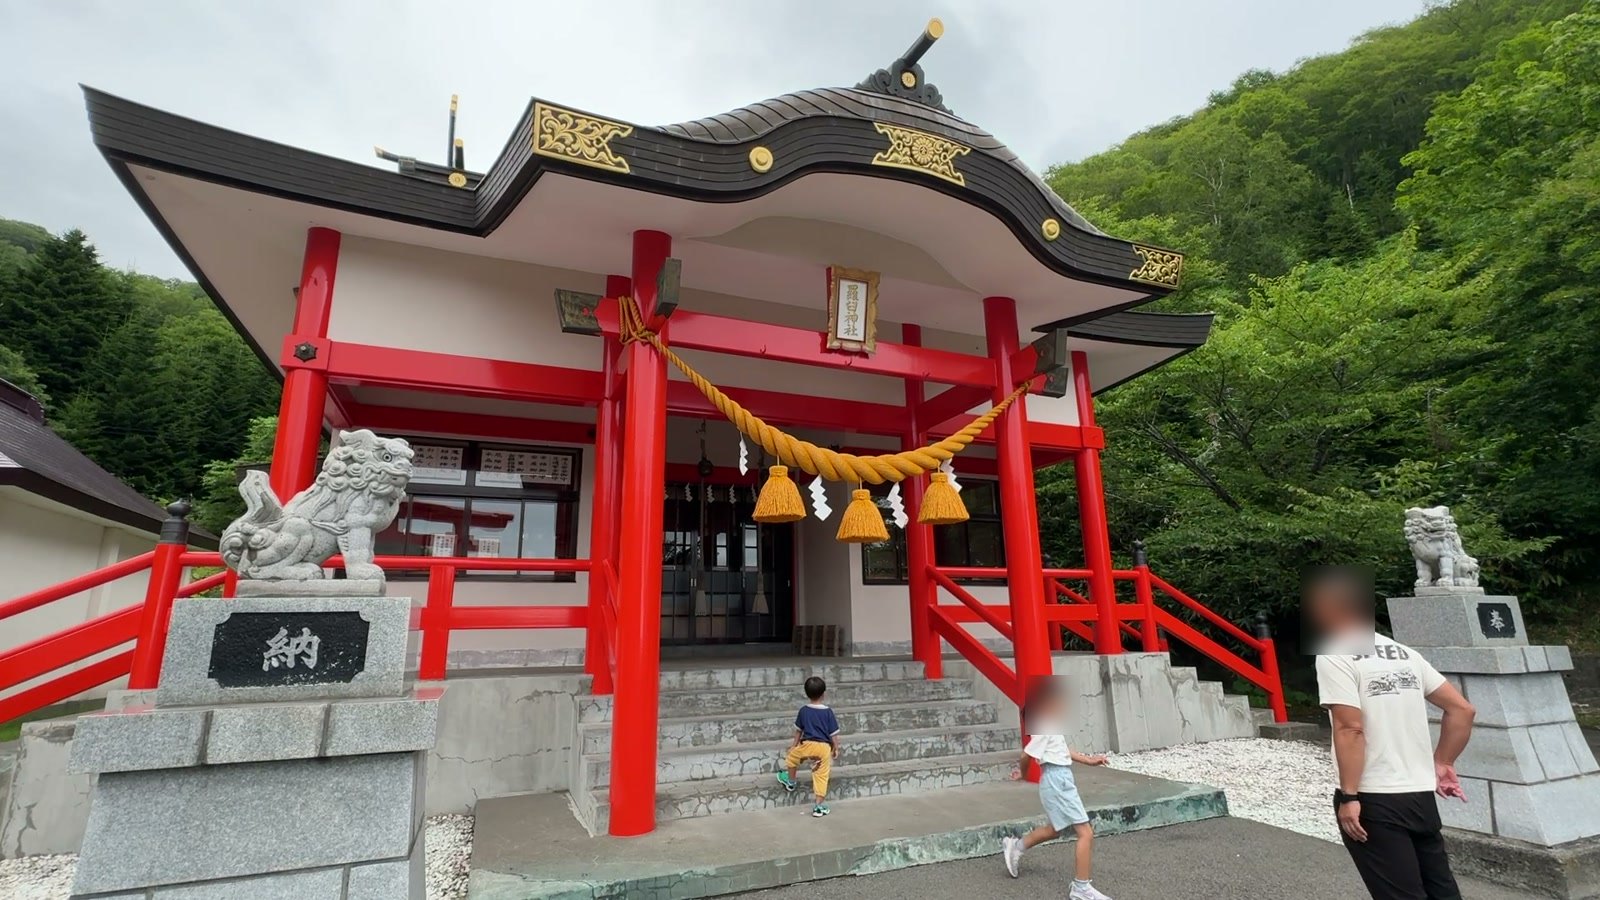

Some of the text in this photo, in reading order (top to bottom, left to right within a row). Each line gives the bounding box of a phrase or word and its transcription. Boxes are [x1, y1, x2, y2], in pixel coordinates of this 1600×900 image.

[843, 284, 860, 337] 羅臼神社
[1490, 609, 1505, 632] 奉
[262, 626, 321, 672] 納
[1352, 644, 1410, 661] EED
